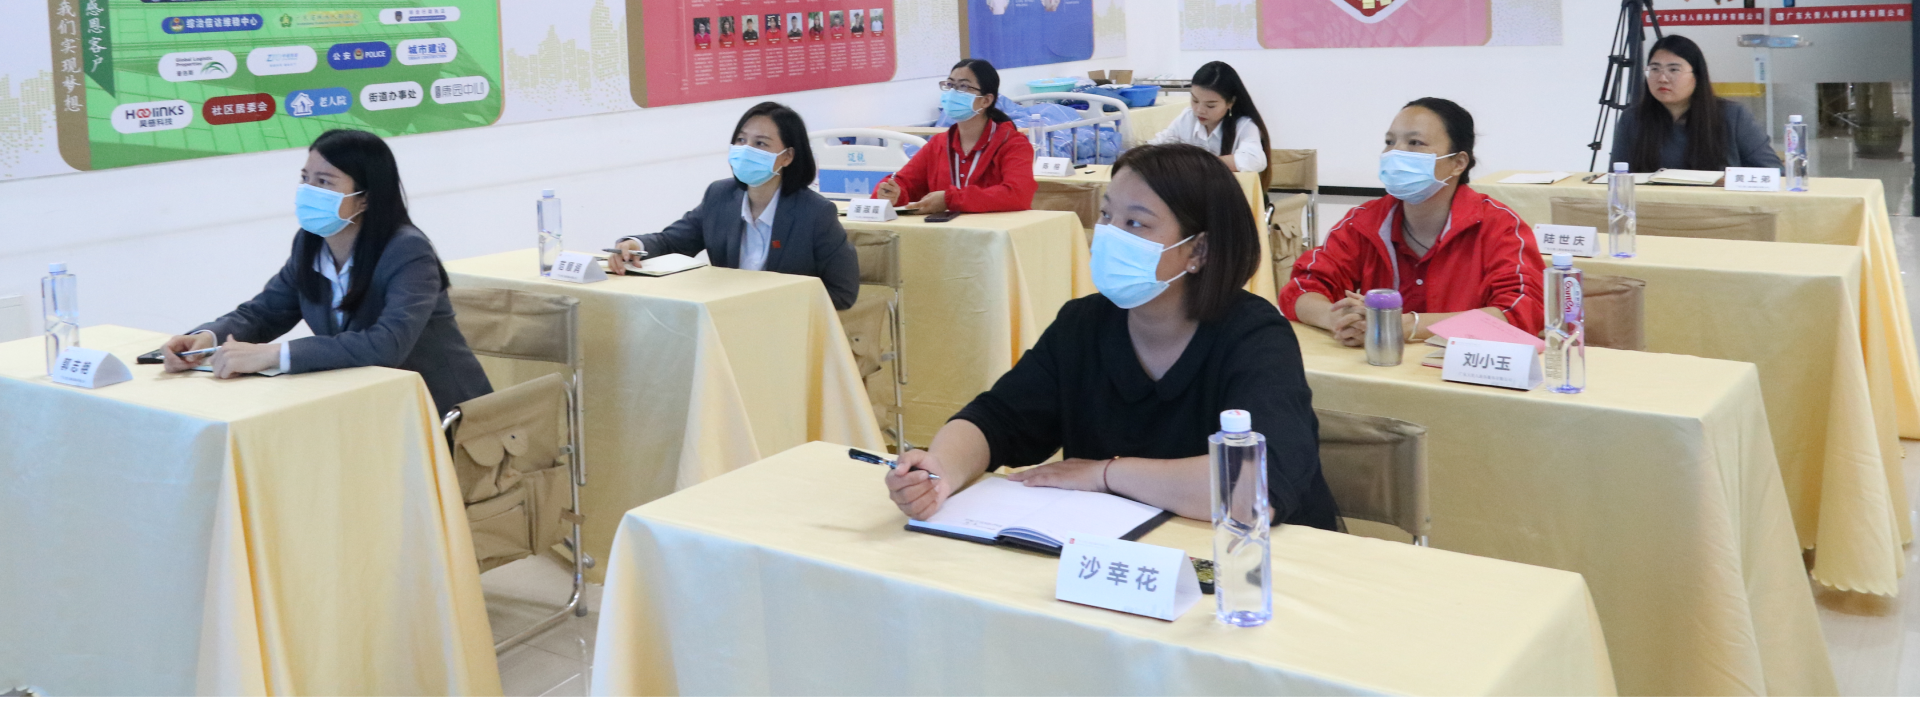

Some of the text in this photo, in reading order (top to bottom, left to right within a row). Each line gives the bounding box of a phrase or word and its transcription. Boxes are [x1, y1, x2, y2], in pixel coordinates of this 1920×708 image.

[56, 0, 83, 112] 我们实现梦想
[332, 50, 387, 61] 公安 POLICE
[407, 43, 447, 55] 城市建设
[319, 95, 348, 107] 老人院
[368, 89, 417, 103] 街道办事处
[211, 101, 268, 116] 社区居委会
[1543, 233, 1585, 246] 陆世庆
[1462, 352, 1512, 371] 刘小玉
[1078, 555, 1160, 592] 沙幸花
